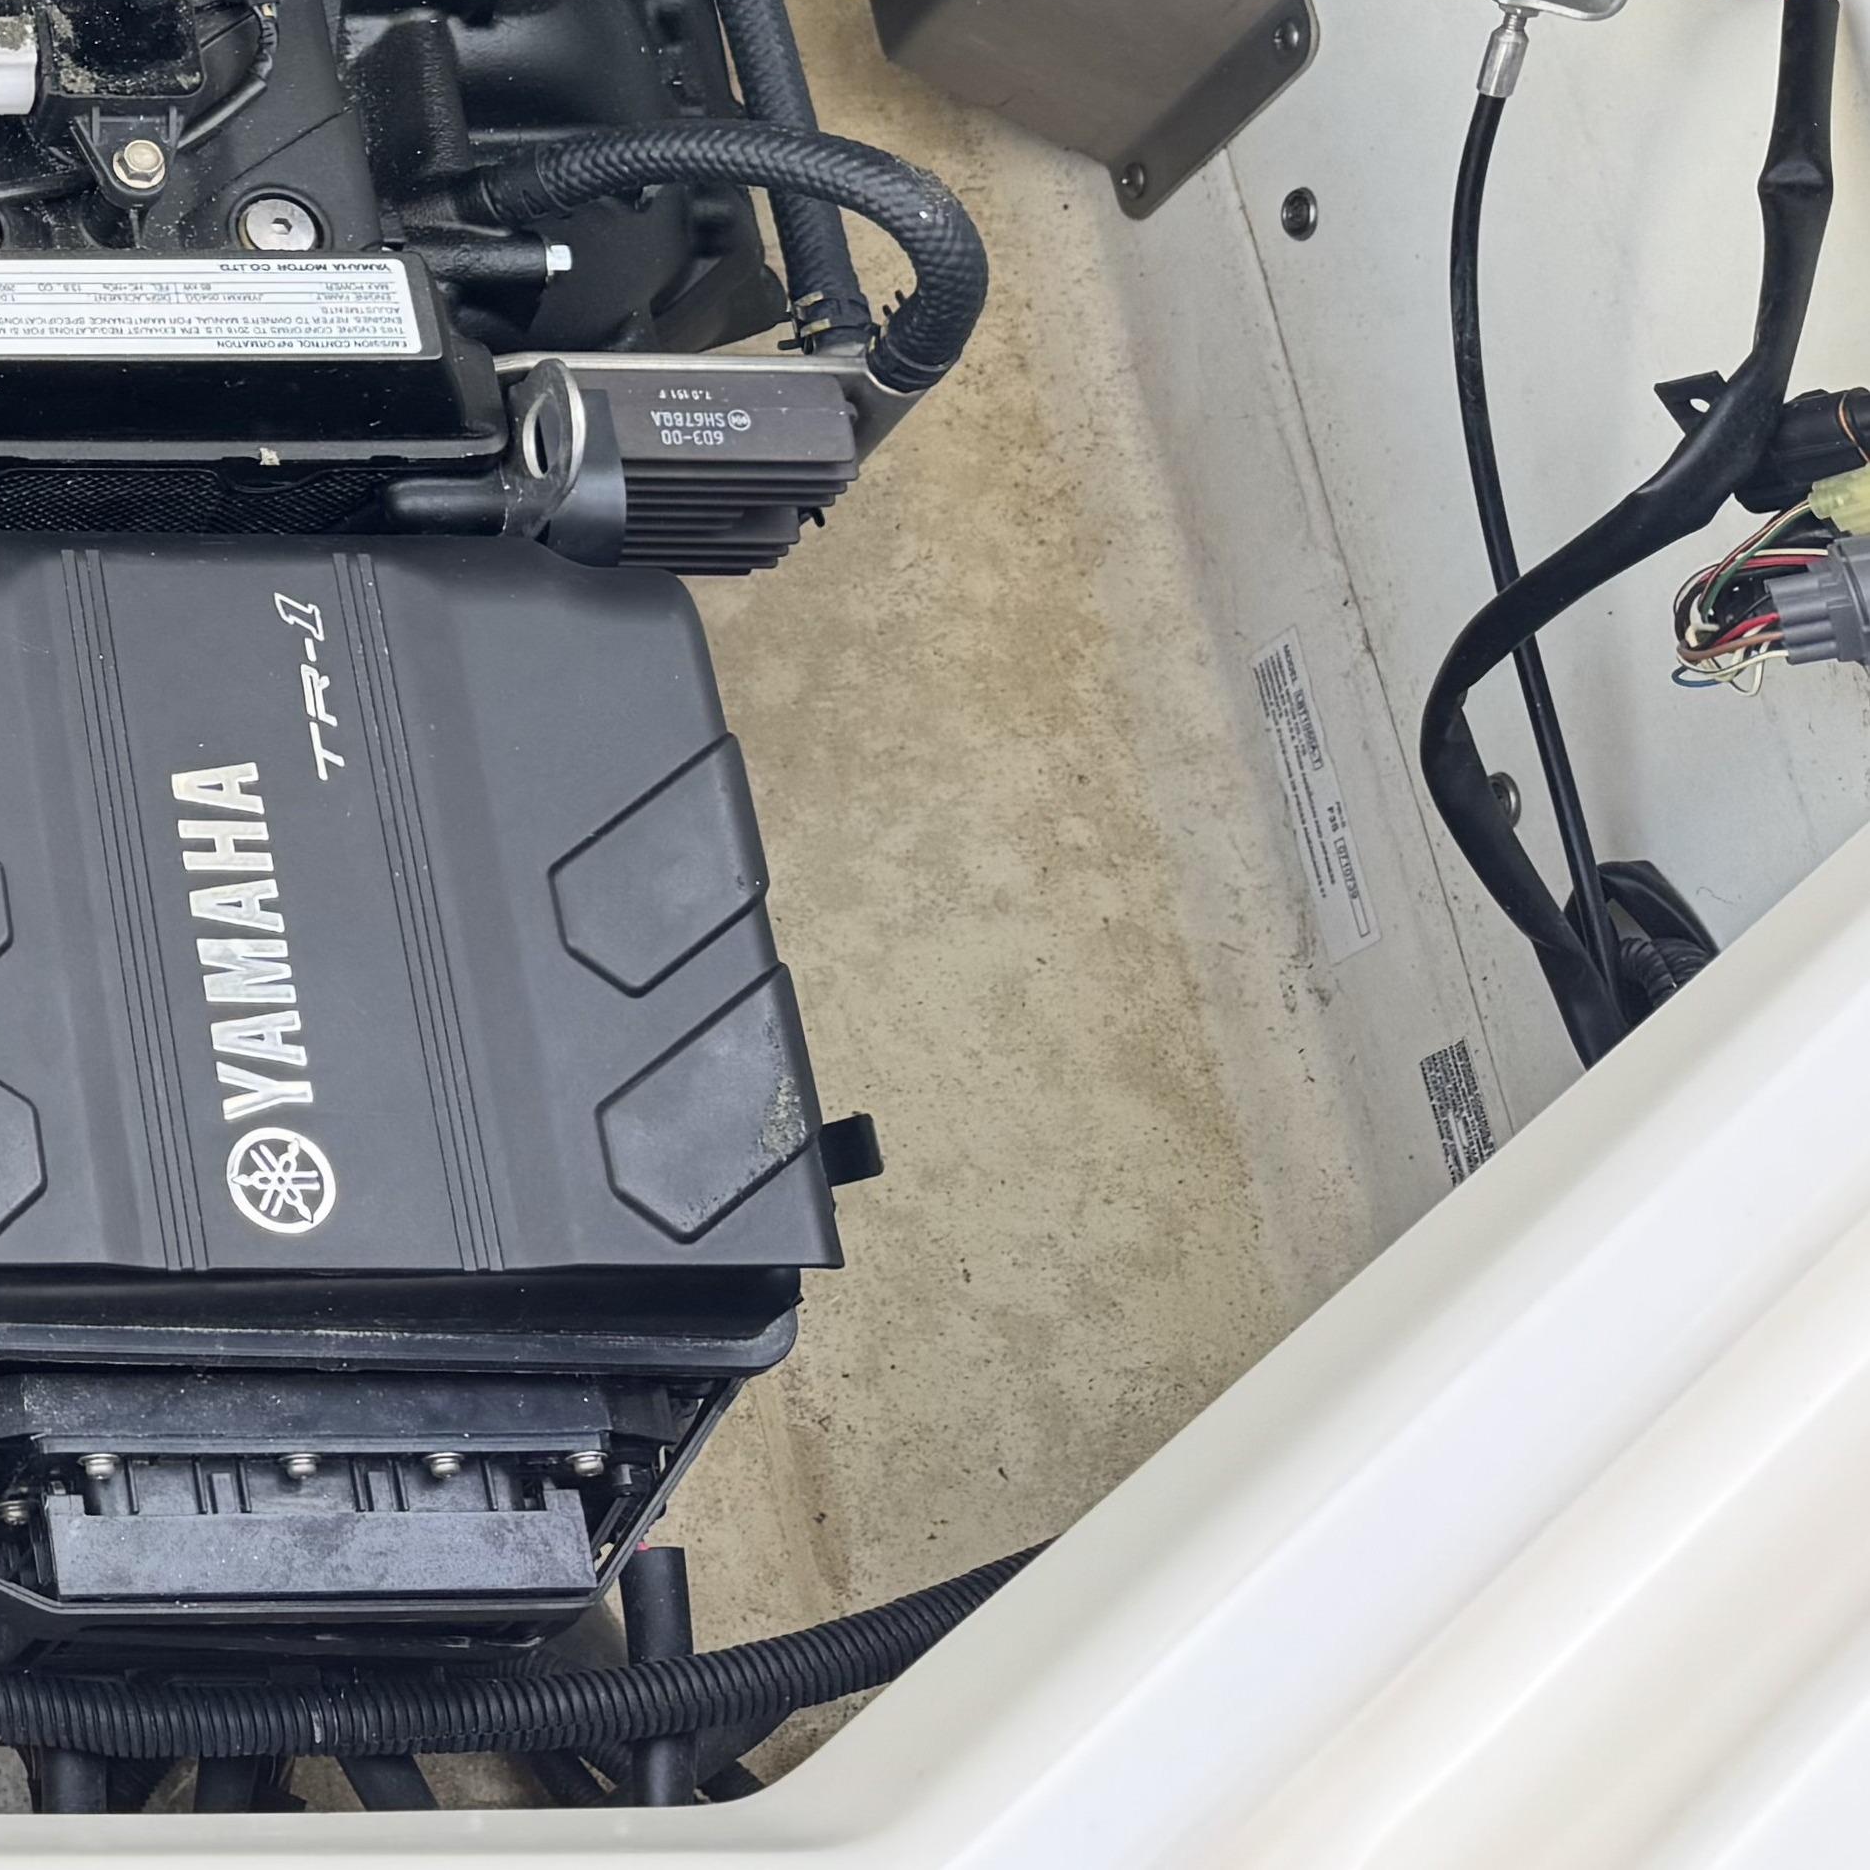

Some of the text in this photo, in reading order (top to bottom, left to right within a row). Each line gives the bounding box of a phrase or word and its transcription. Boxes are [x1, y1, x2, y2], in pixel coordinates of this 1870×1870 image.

[296, 339, 351, 347] CONTROL
[353, 339, 407, 347] EMISSION
[171, 760, 315, 1122] YAMAHA
